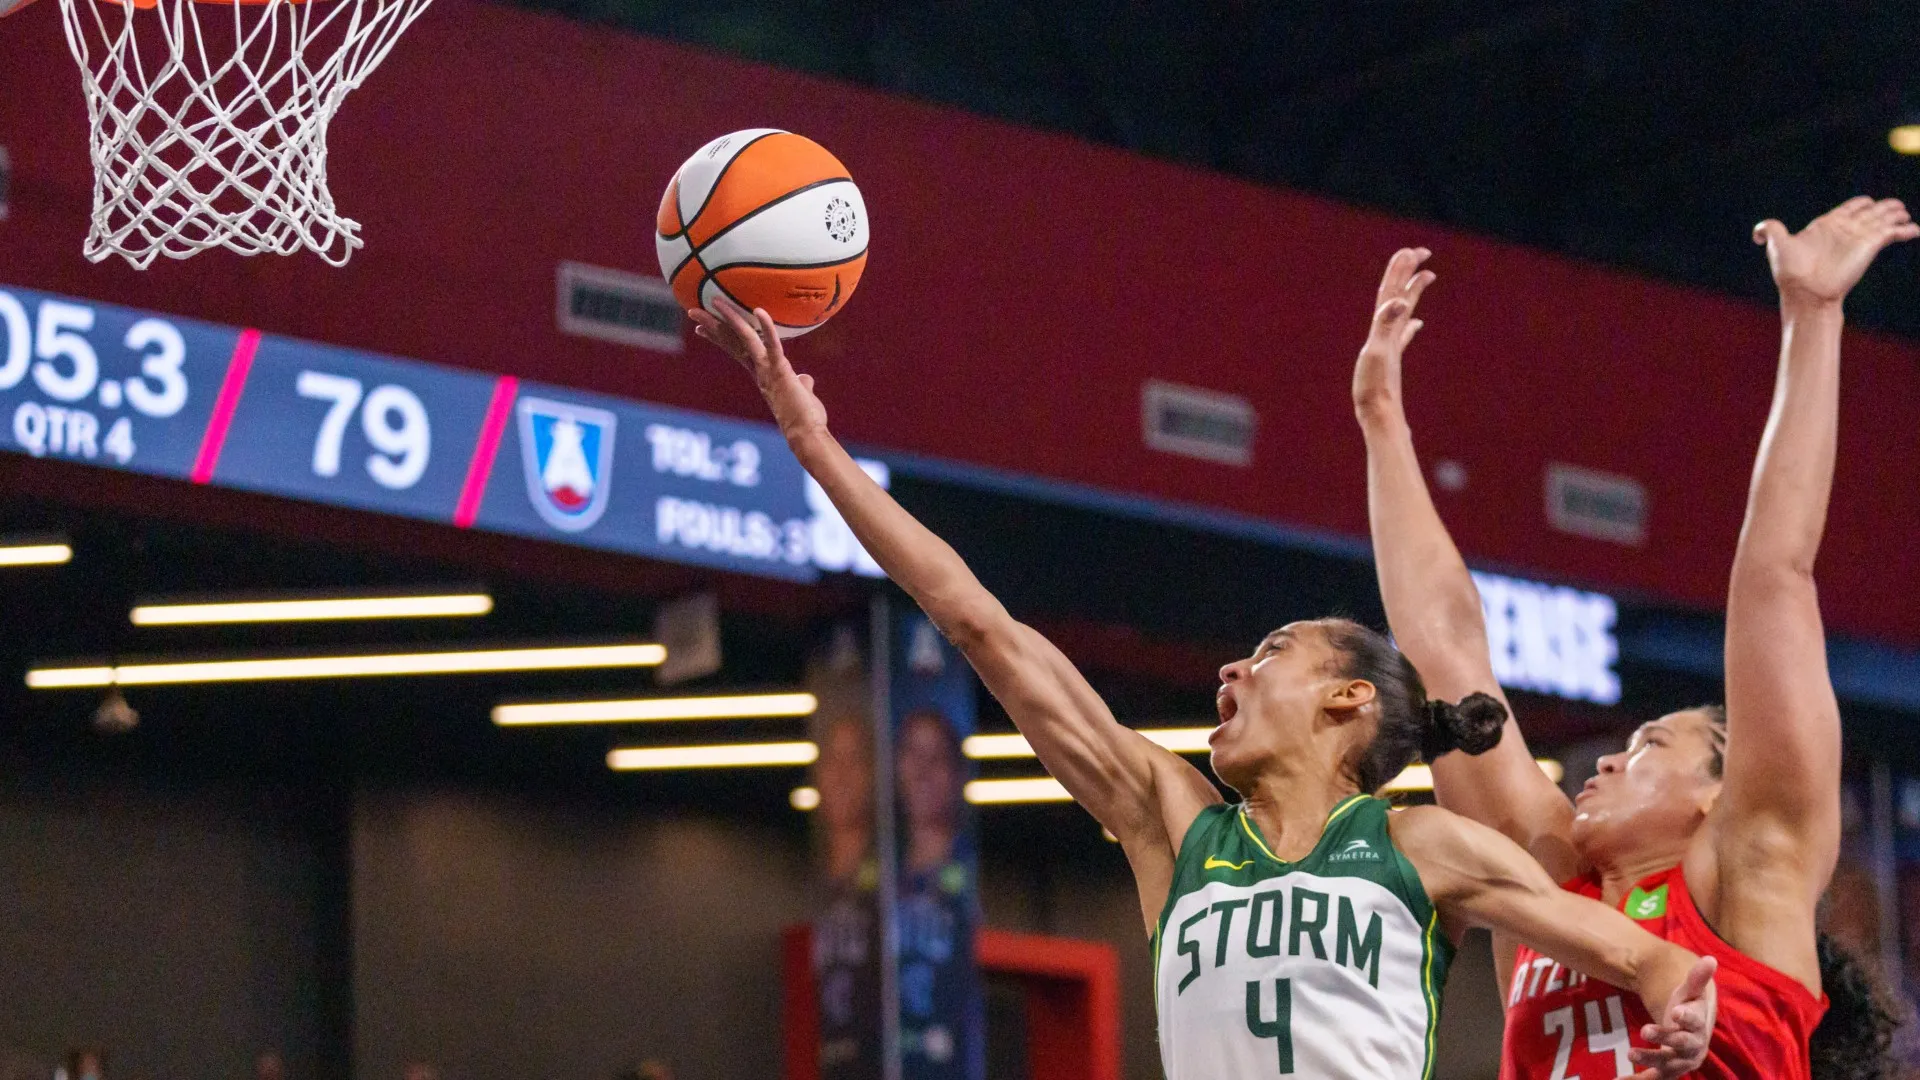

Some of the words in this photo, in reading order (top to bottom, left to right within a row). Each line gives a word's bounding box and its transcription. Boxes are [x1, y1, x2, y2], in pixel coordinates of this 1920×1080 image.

[13, 402, 98, 460] QTR
[104, 417, 136, 465] 4
[297, 370, 431, 489] 79
[1328, 851, 1380, 861] SYMETRA
[1177, 886, 1383, 997] STORM
[1246, 977, 1294, 1075] 4
[1543, 995, 1634, 1080] 24
